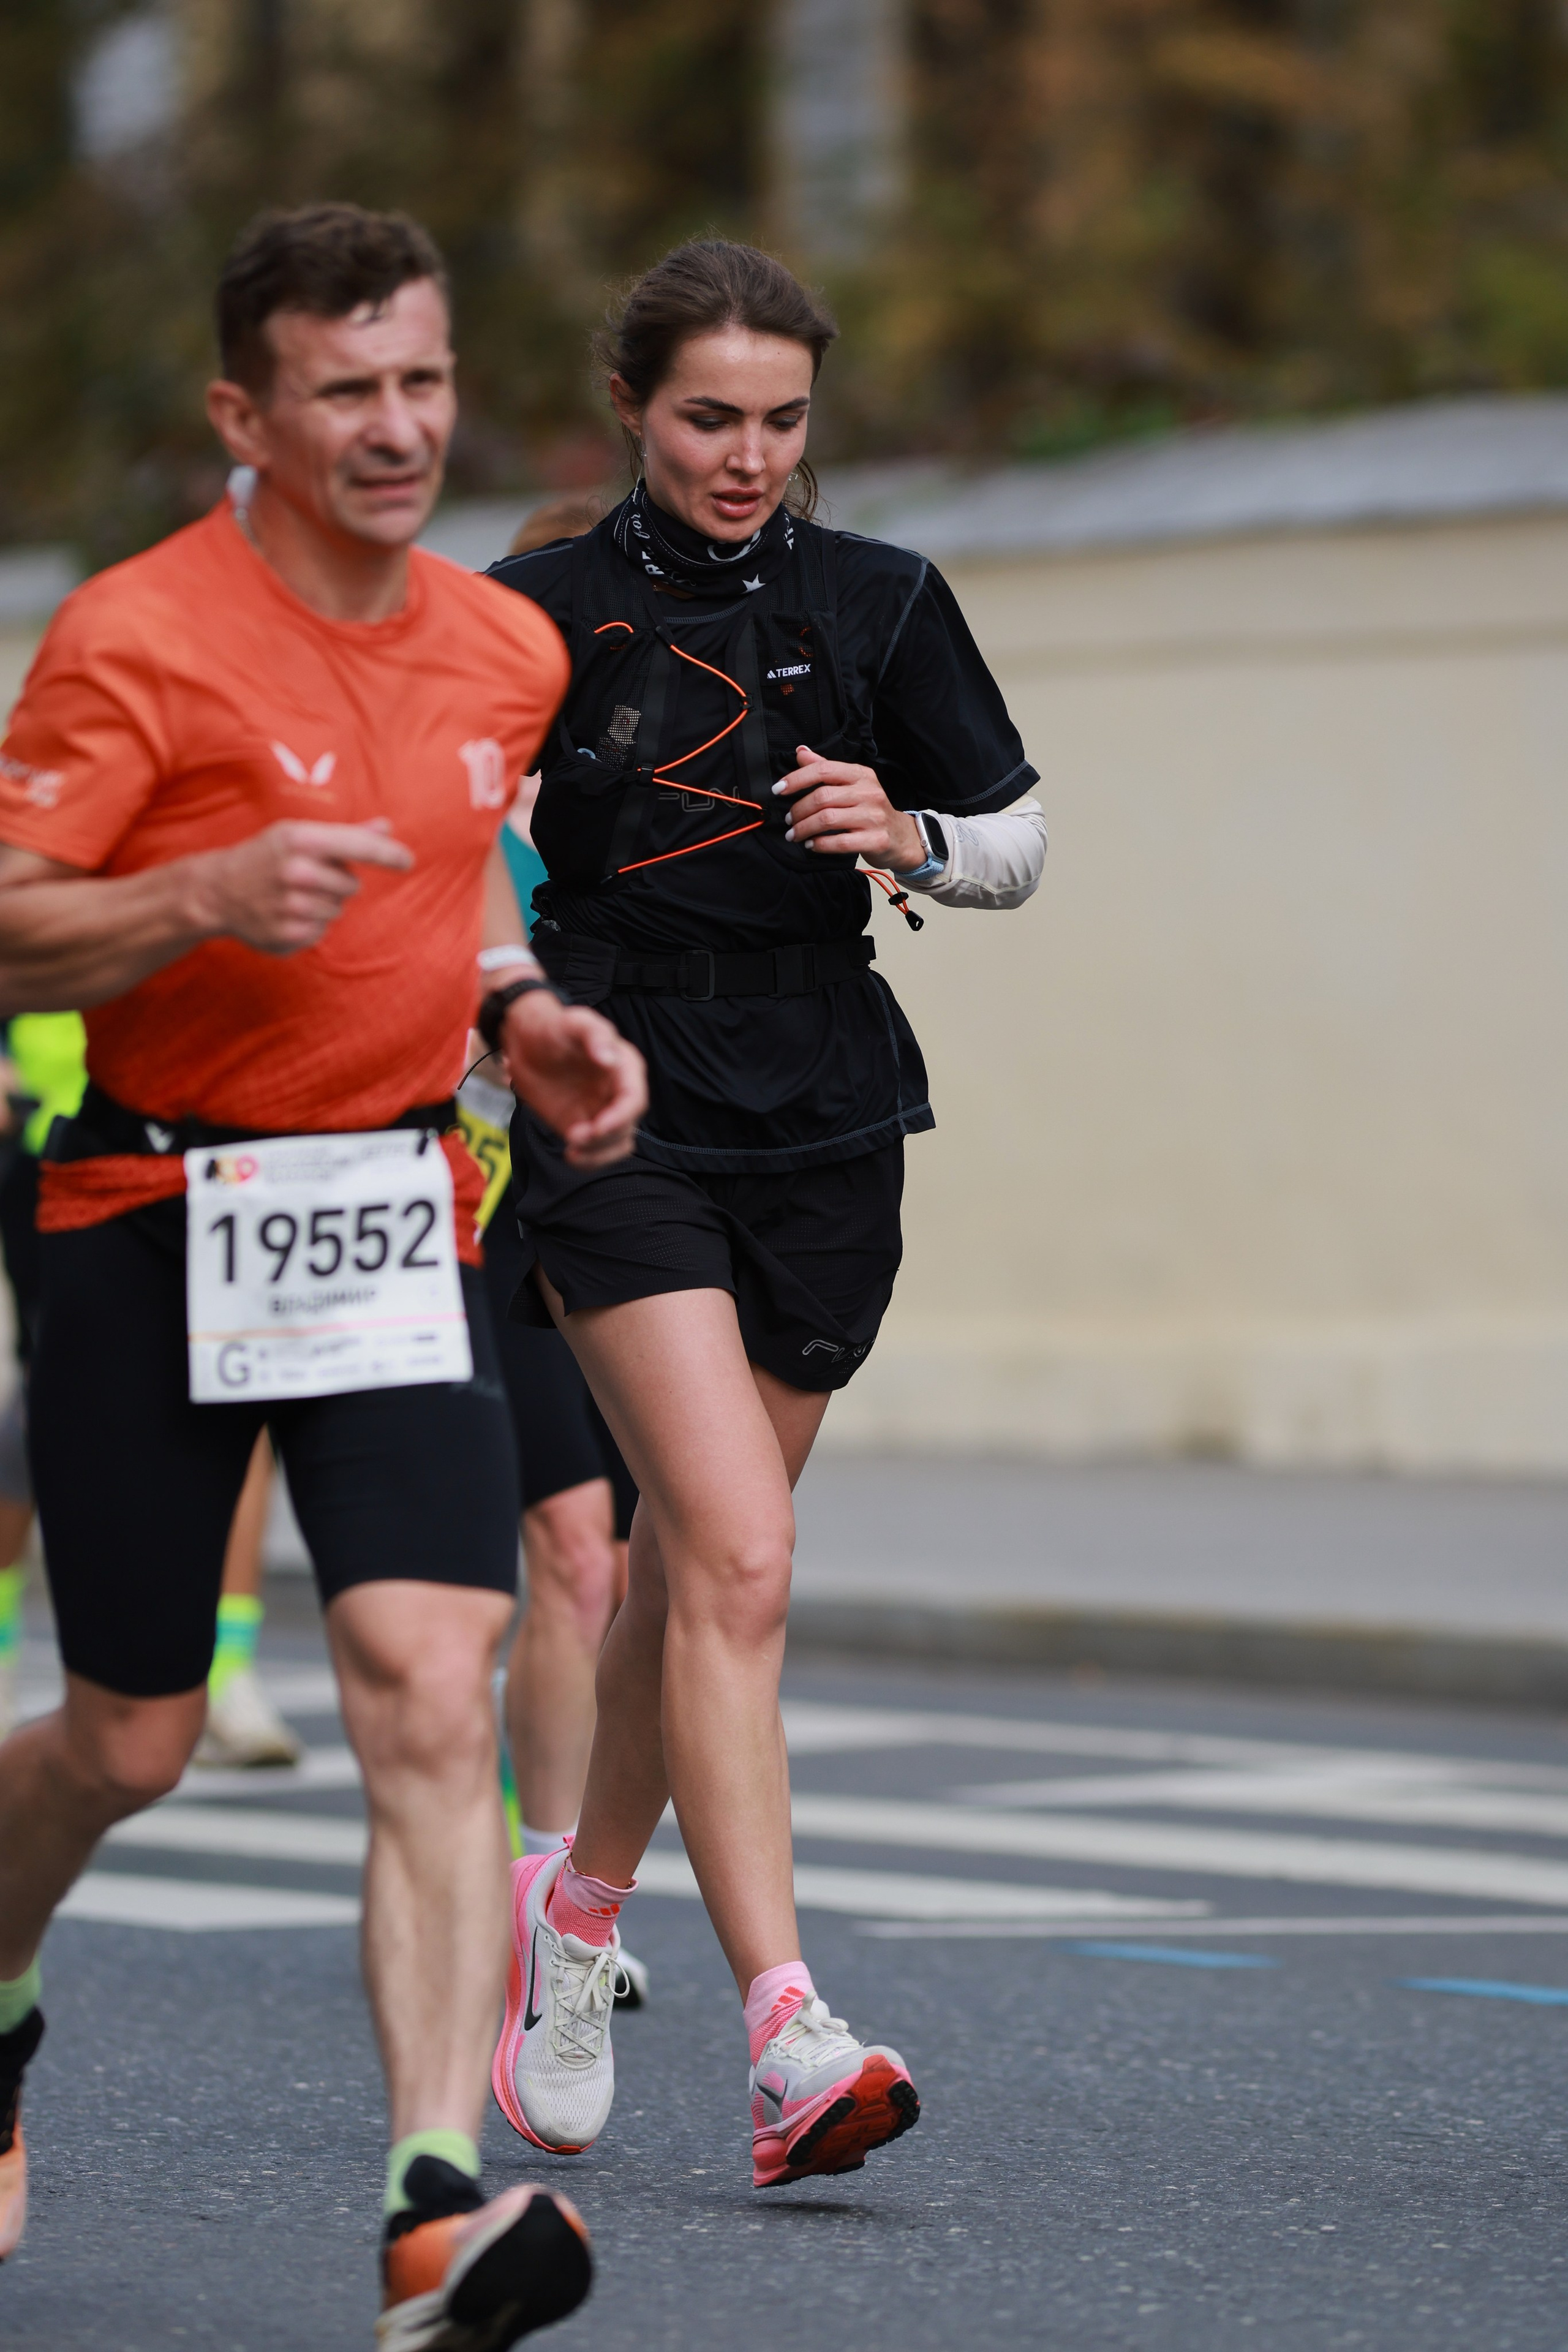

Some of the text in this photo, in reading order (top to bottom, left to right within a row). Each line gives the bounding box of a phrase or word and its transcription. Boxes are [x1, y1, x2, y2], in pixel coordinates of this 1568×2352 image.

[775, 663, 812, 677] TERREX
[209, 1200, 439, 1283] 19552
[217, 1341, 251, 1388] G
